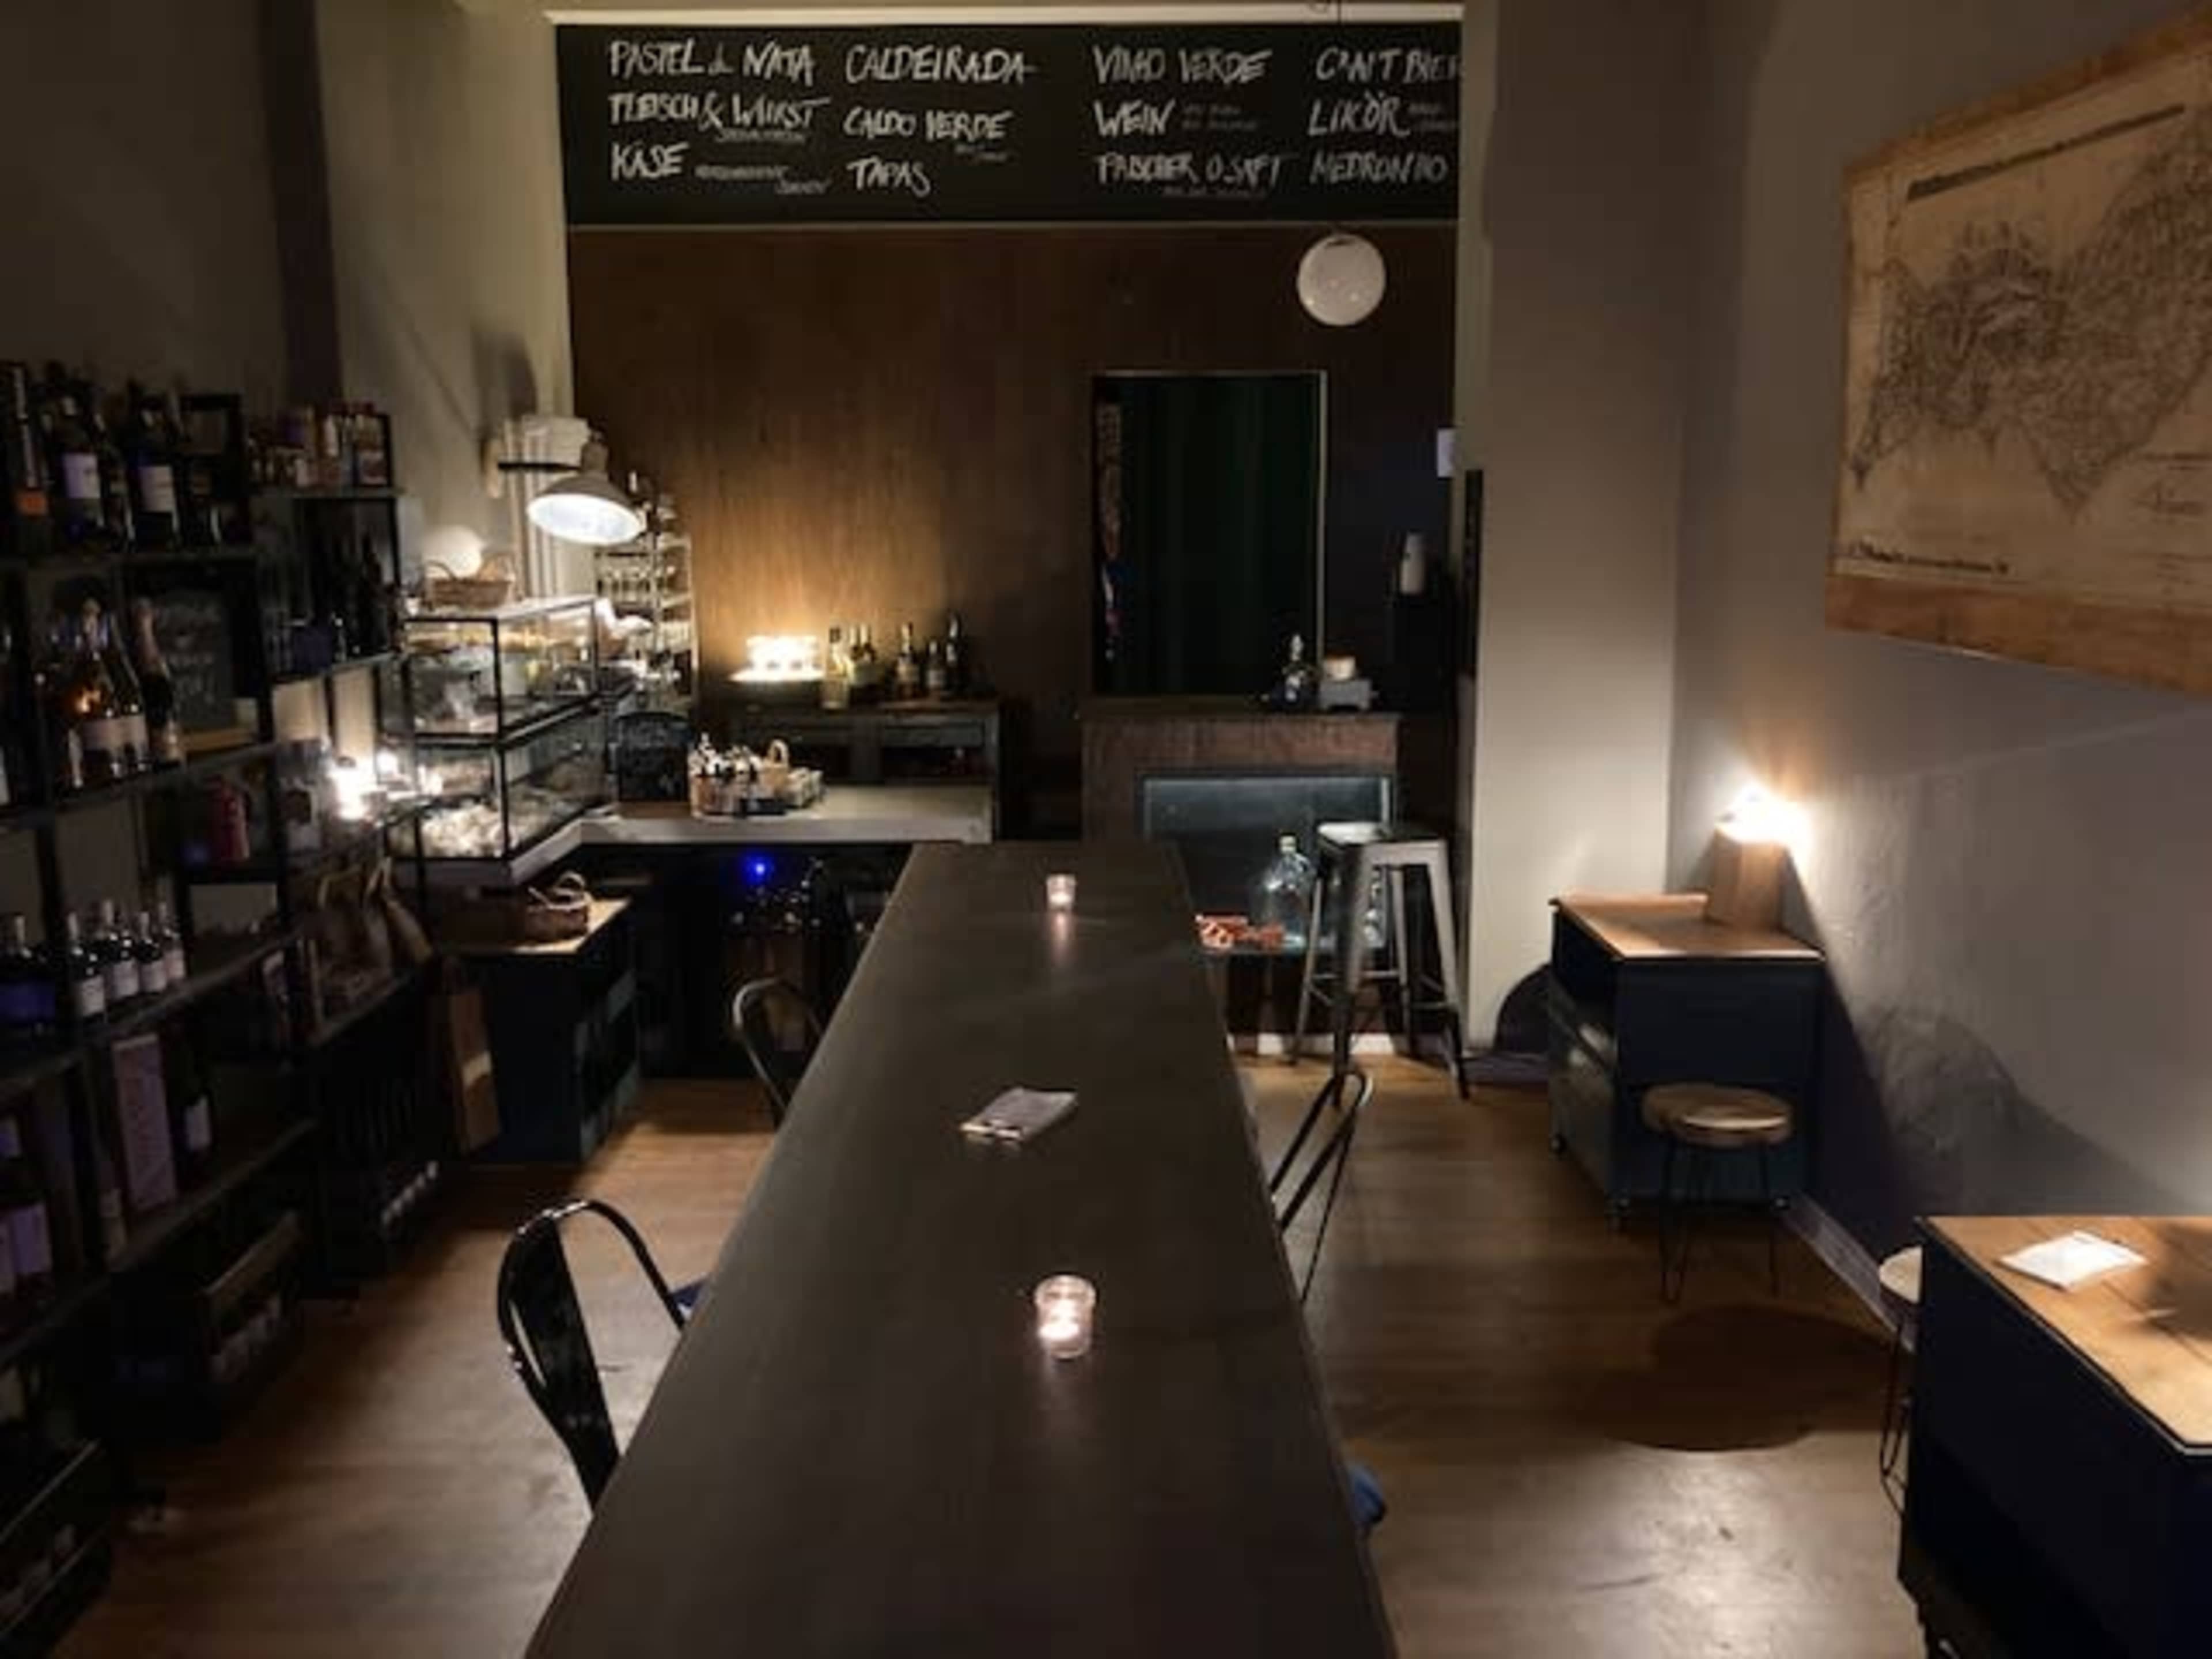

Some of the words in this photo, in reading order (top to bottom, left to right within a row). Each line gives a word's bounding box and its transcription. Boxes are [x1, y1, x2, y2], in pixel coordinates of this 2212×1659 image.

[610, 38, 706, 80] PASTEL
[741, 40, 815, 87] NATA
[845, 43, 1040, 85] CALDEIRADA
[1093, 44, 1167, 85] VINHO
[1179, 47, 1274, 88] VERDE
[730, 93, 831, 130] WURST
[842, 106, 918, 140] CALDO
[925, 108, 1014, 143] VERDE
[1093, 98, 1176, 138] WEIN
[846, 154, 931, 198] TAPAS
